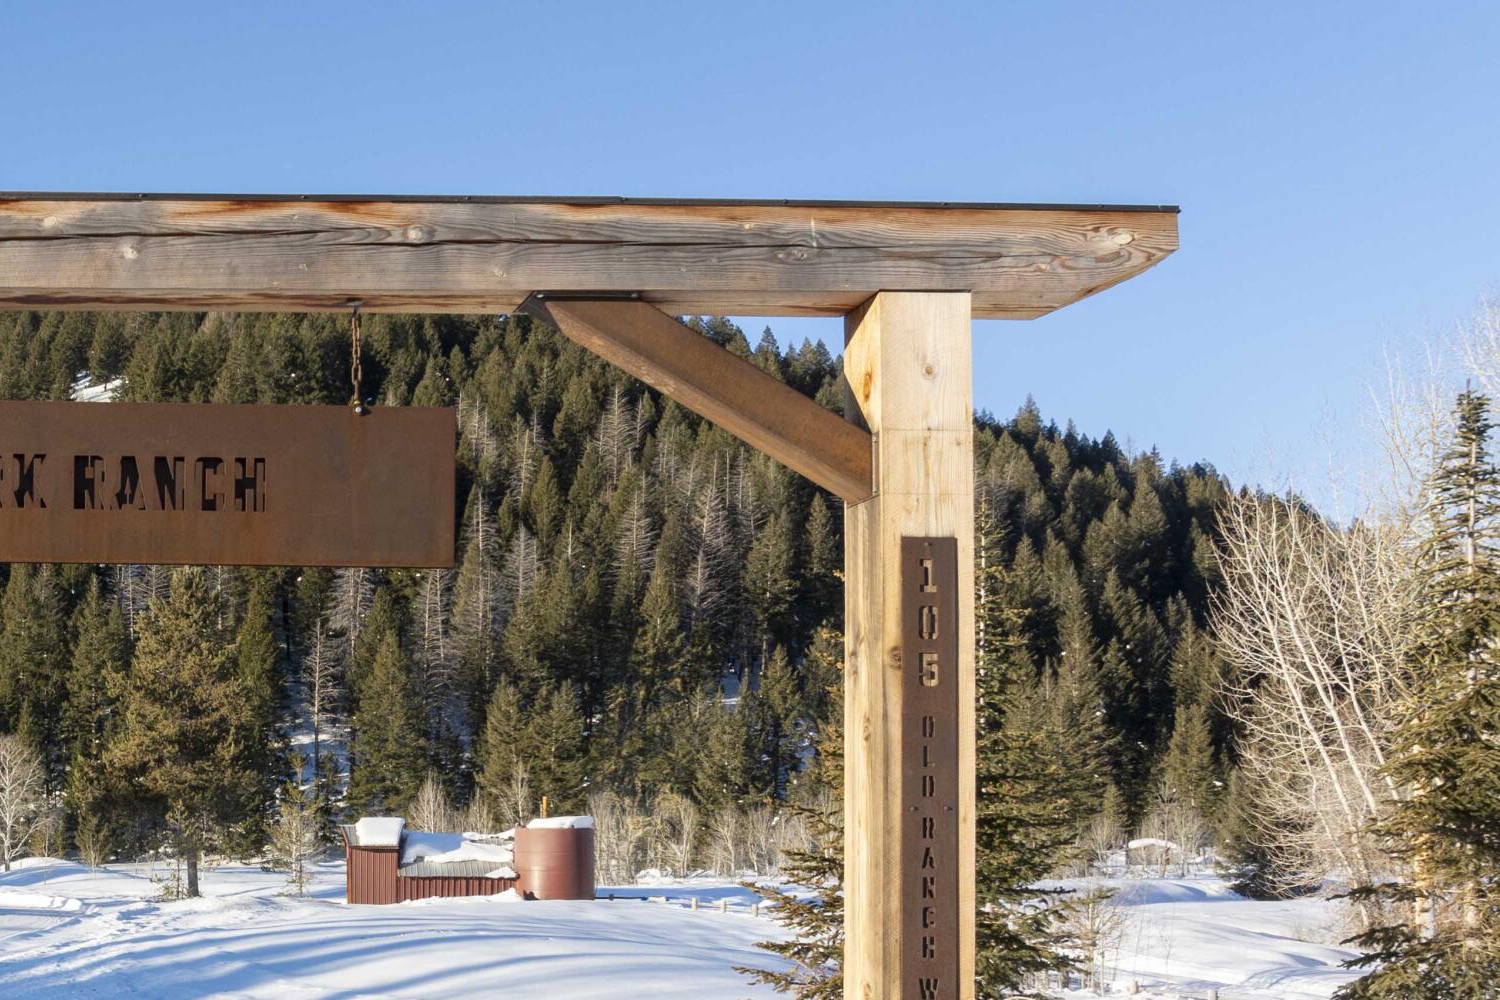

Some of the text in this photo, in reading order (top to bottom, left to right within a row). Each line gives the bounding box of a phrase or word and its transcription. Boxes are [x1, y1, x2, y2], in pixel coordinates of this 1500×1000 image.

[73, 454, 267, 513] RANCH
[918, 558, 940, 688] 105
[920, 816, 937, 959] RANCH
